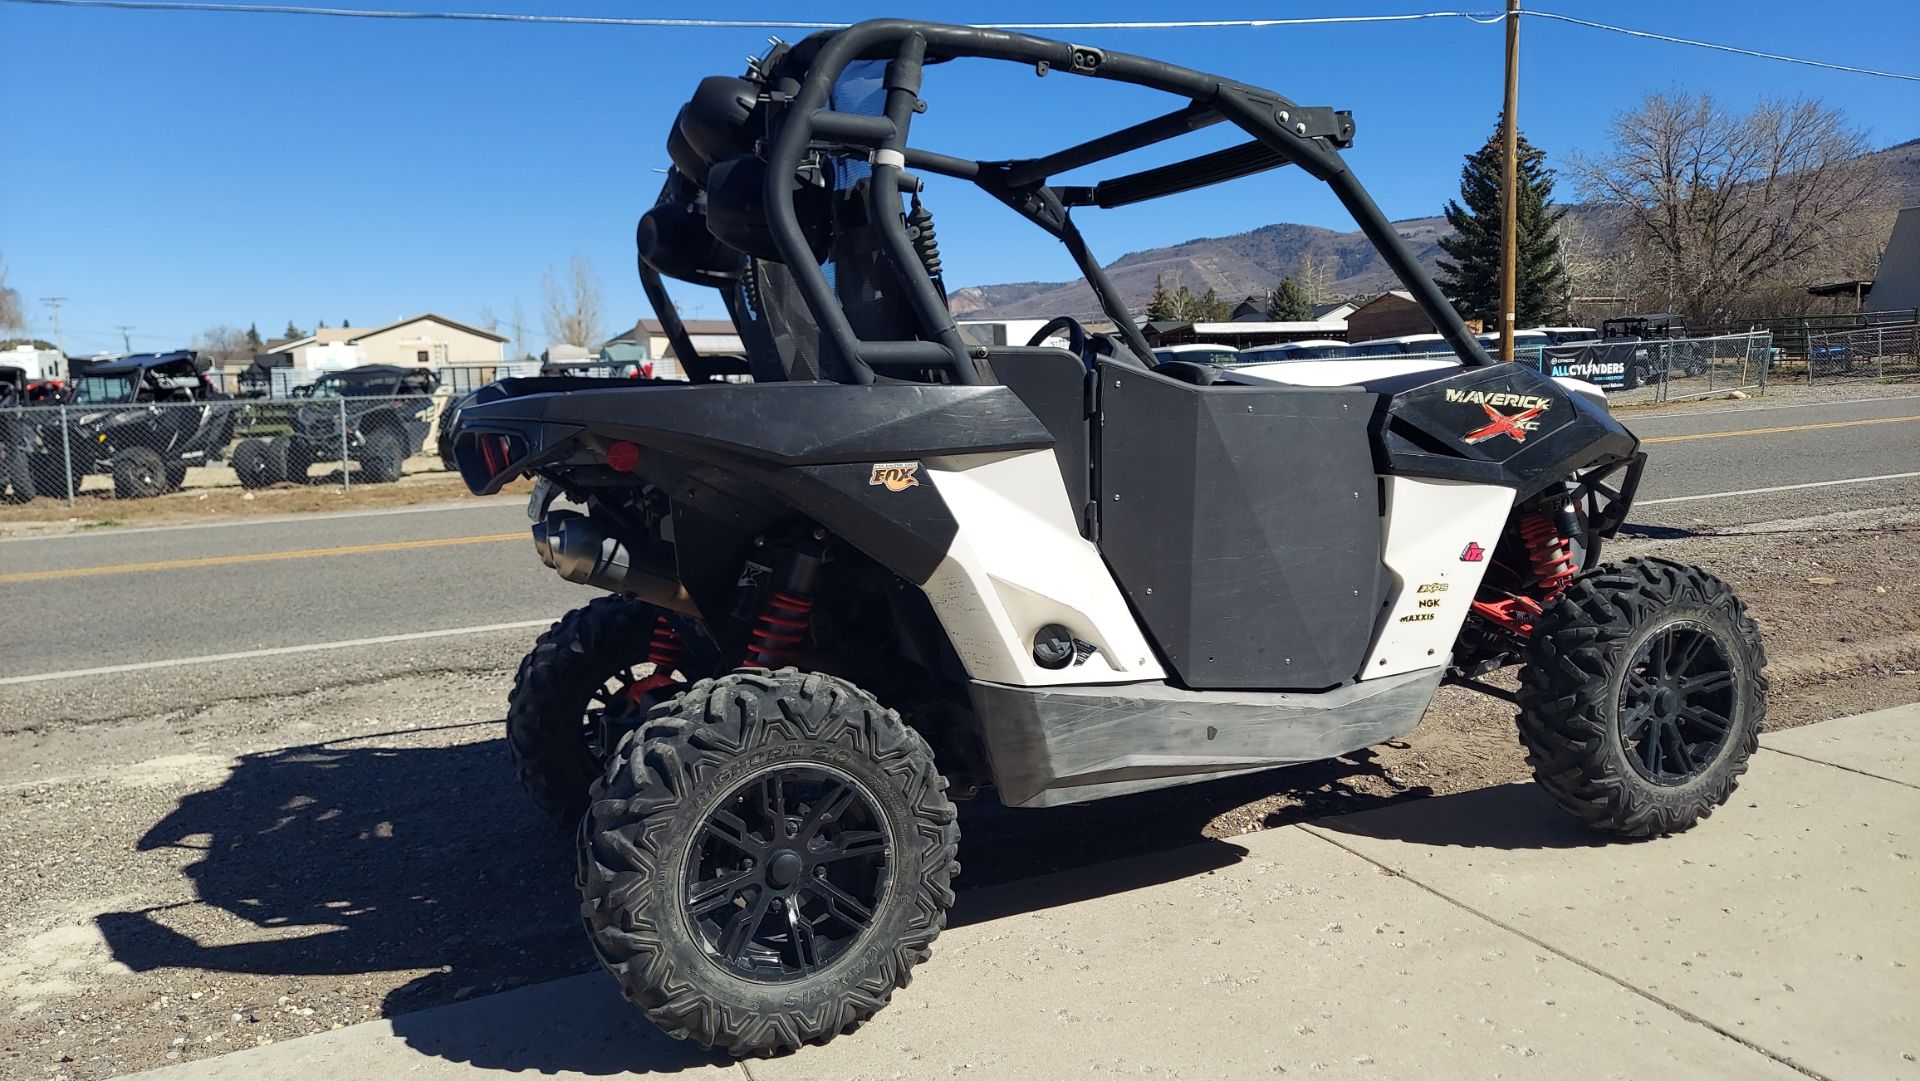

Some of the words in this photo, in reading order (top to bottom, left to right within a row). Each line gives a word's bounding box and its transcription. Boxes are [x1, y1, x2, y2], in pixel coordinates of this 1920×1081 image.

[1446, 388, 1552, 410] MAVERICK
[873, 468, 914, 482] FOX
[1418, 599, 1441, 608] NGK
[1399, 613, 1435, 623] MAXXIS
[695, 743, 805, 808] BIGHORN
